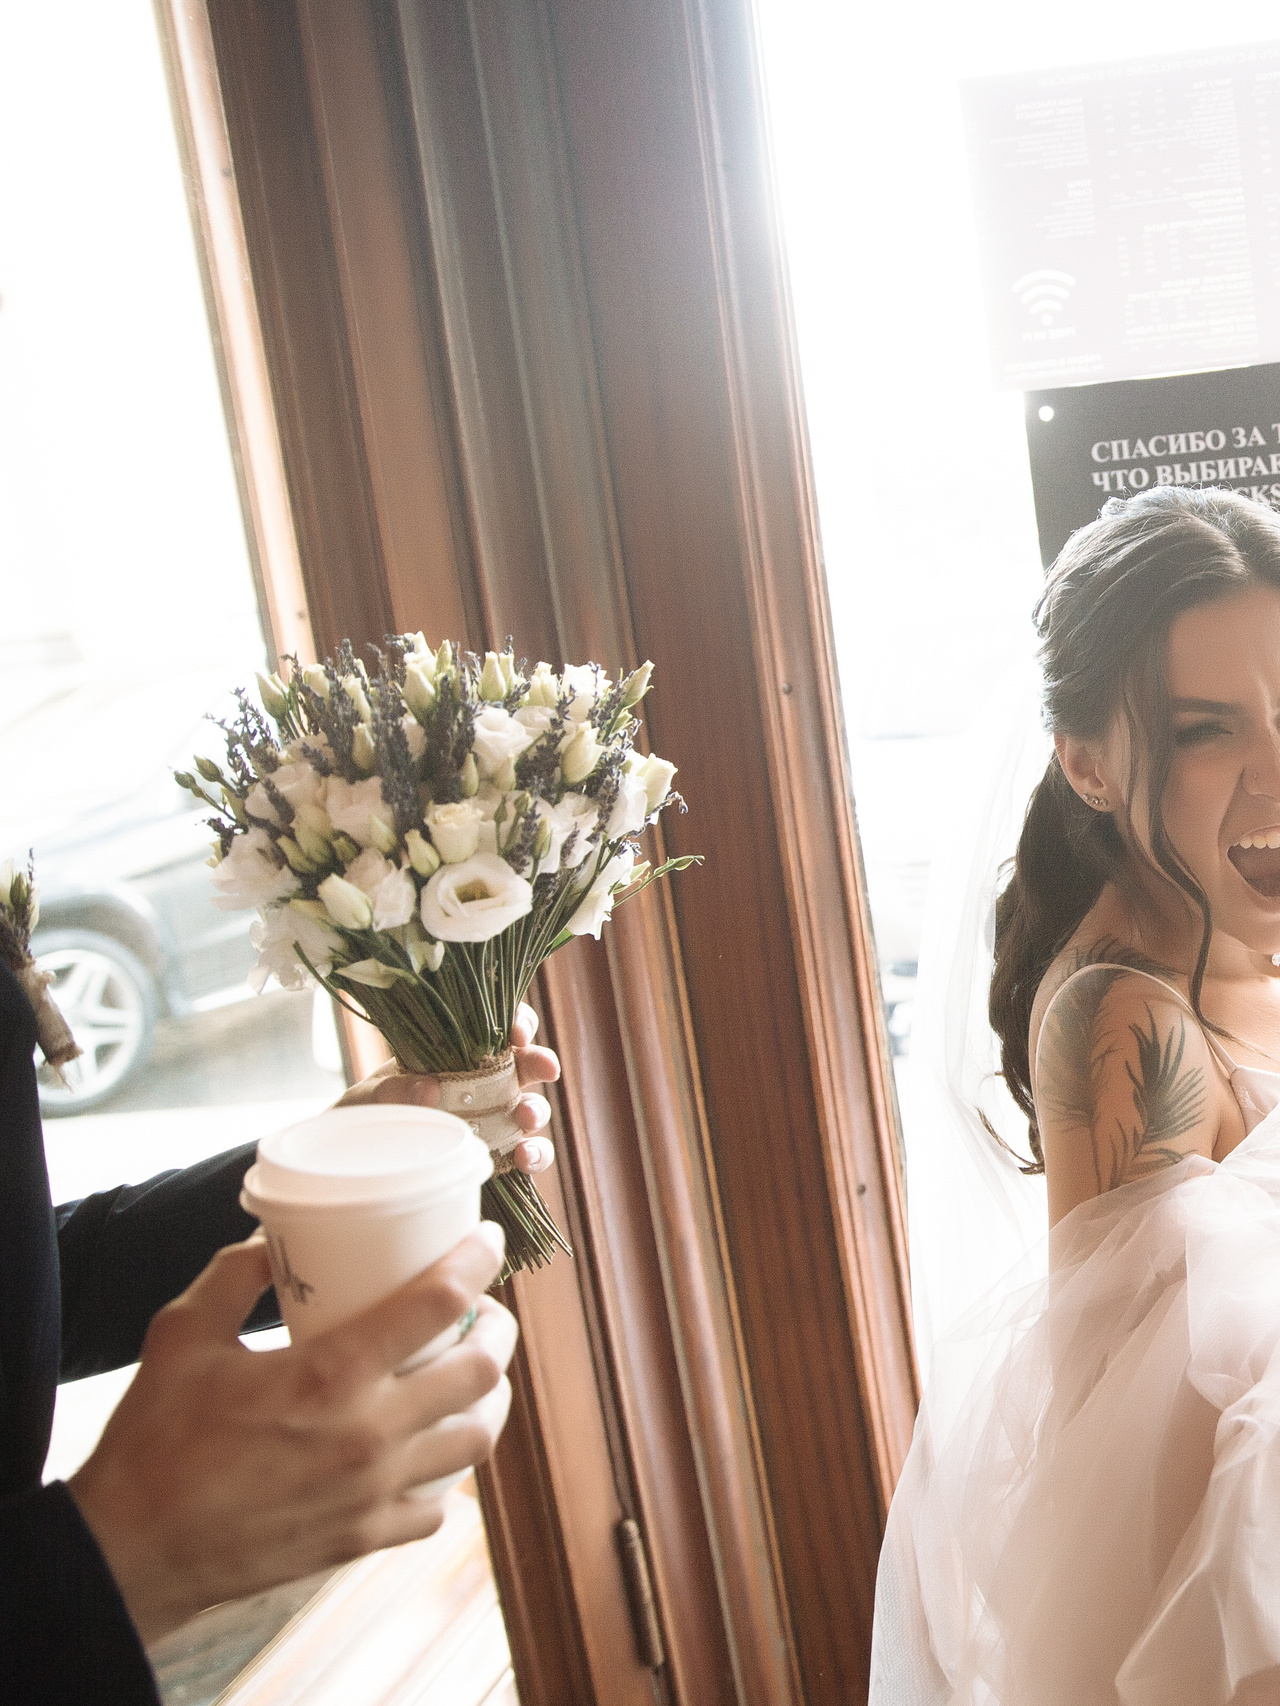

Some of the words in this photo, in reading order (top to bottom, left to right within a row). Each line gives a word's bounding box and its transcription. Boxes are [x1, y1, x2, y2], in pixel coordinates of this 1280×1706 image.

[1091, 429, 1227, 463] СПАСИБО
[1232, 426, 1267, 449] ЗА
[1092, 467, 1149, 493] ЧТО
